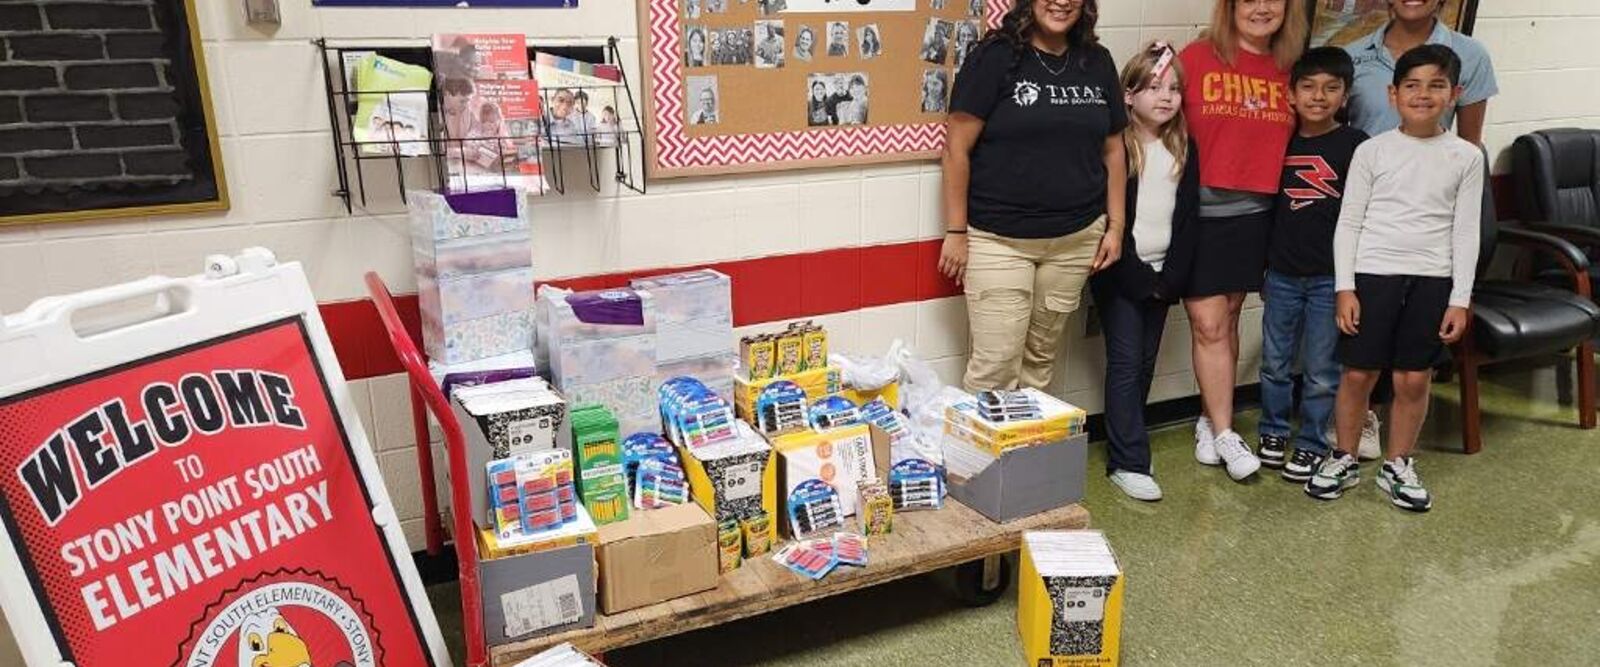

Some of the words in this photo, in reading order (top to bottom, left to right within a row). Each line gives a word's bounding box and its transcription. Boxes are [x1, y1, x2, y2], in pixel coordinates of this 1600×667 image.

[1202, 72, 1284, 110] CHIEF
[17, 369, 307, 527] WELCOME
[174, 454, 204, 483] TO
[61, 510, 158, 577] STONY
[162, 476, 243, 535] POINT
[245, 444, 323, 499] SOUTH
[80, 480, 333, 632] ELEMENTARY
[206, 600, 254, 648] SOUTH
[255, 587, 343, 616] ELEMENTARY
[343, 618, 371, 664] STONY
